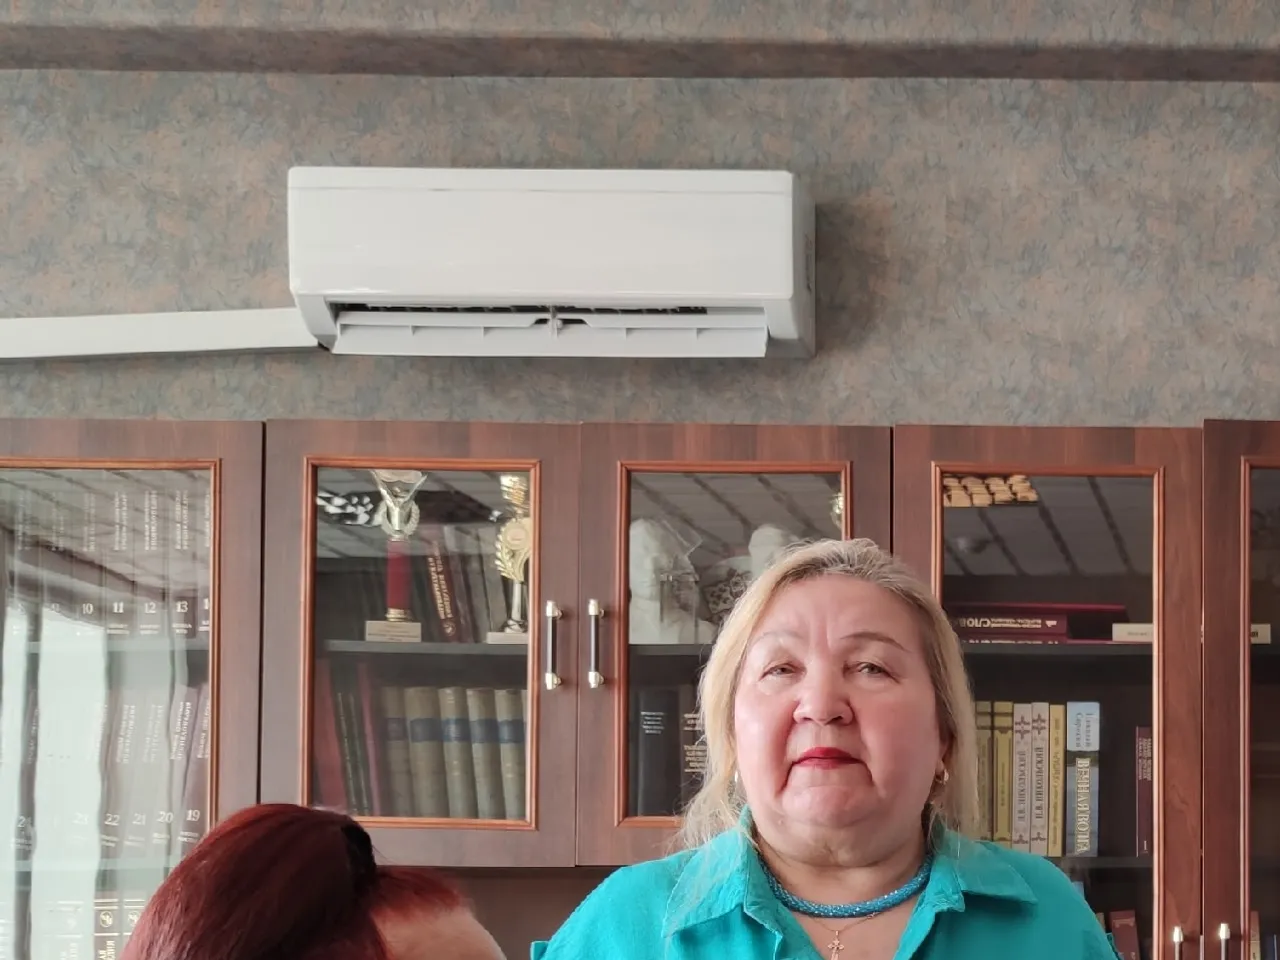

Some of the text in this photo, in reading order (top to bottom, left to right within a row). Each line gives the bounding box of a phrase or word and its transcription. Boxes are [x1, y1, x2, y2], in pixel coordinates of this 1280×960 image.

[176, 601, 188, 613] 13
[157, 811, 174, 823] 20
[186, 809, 201, 821] 19
